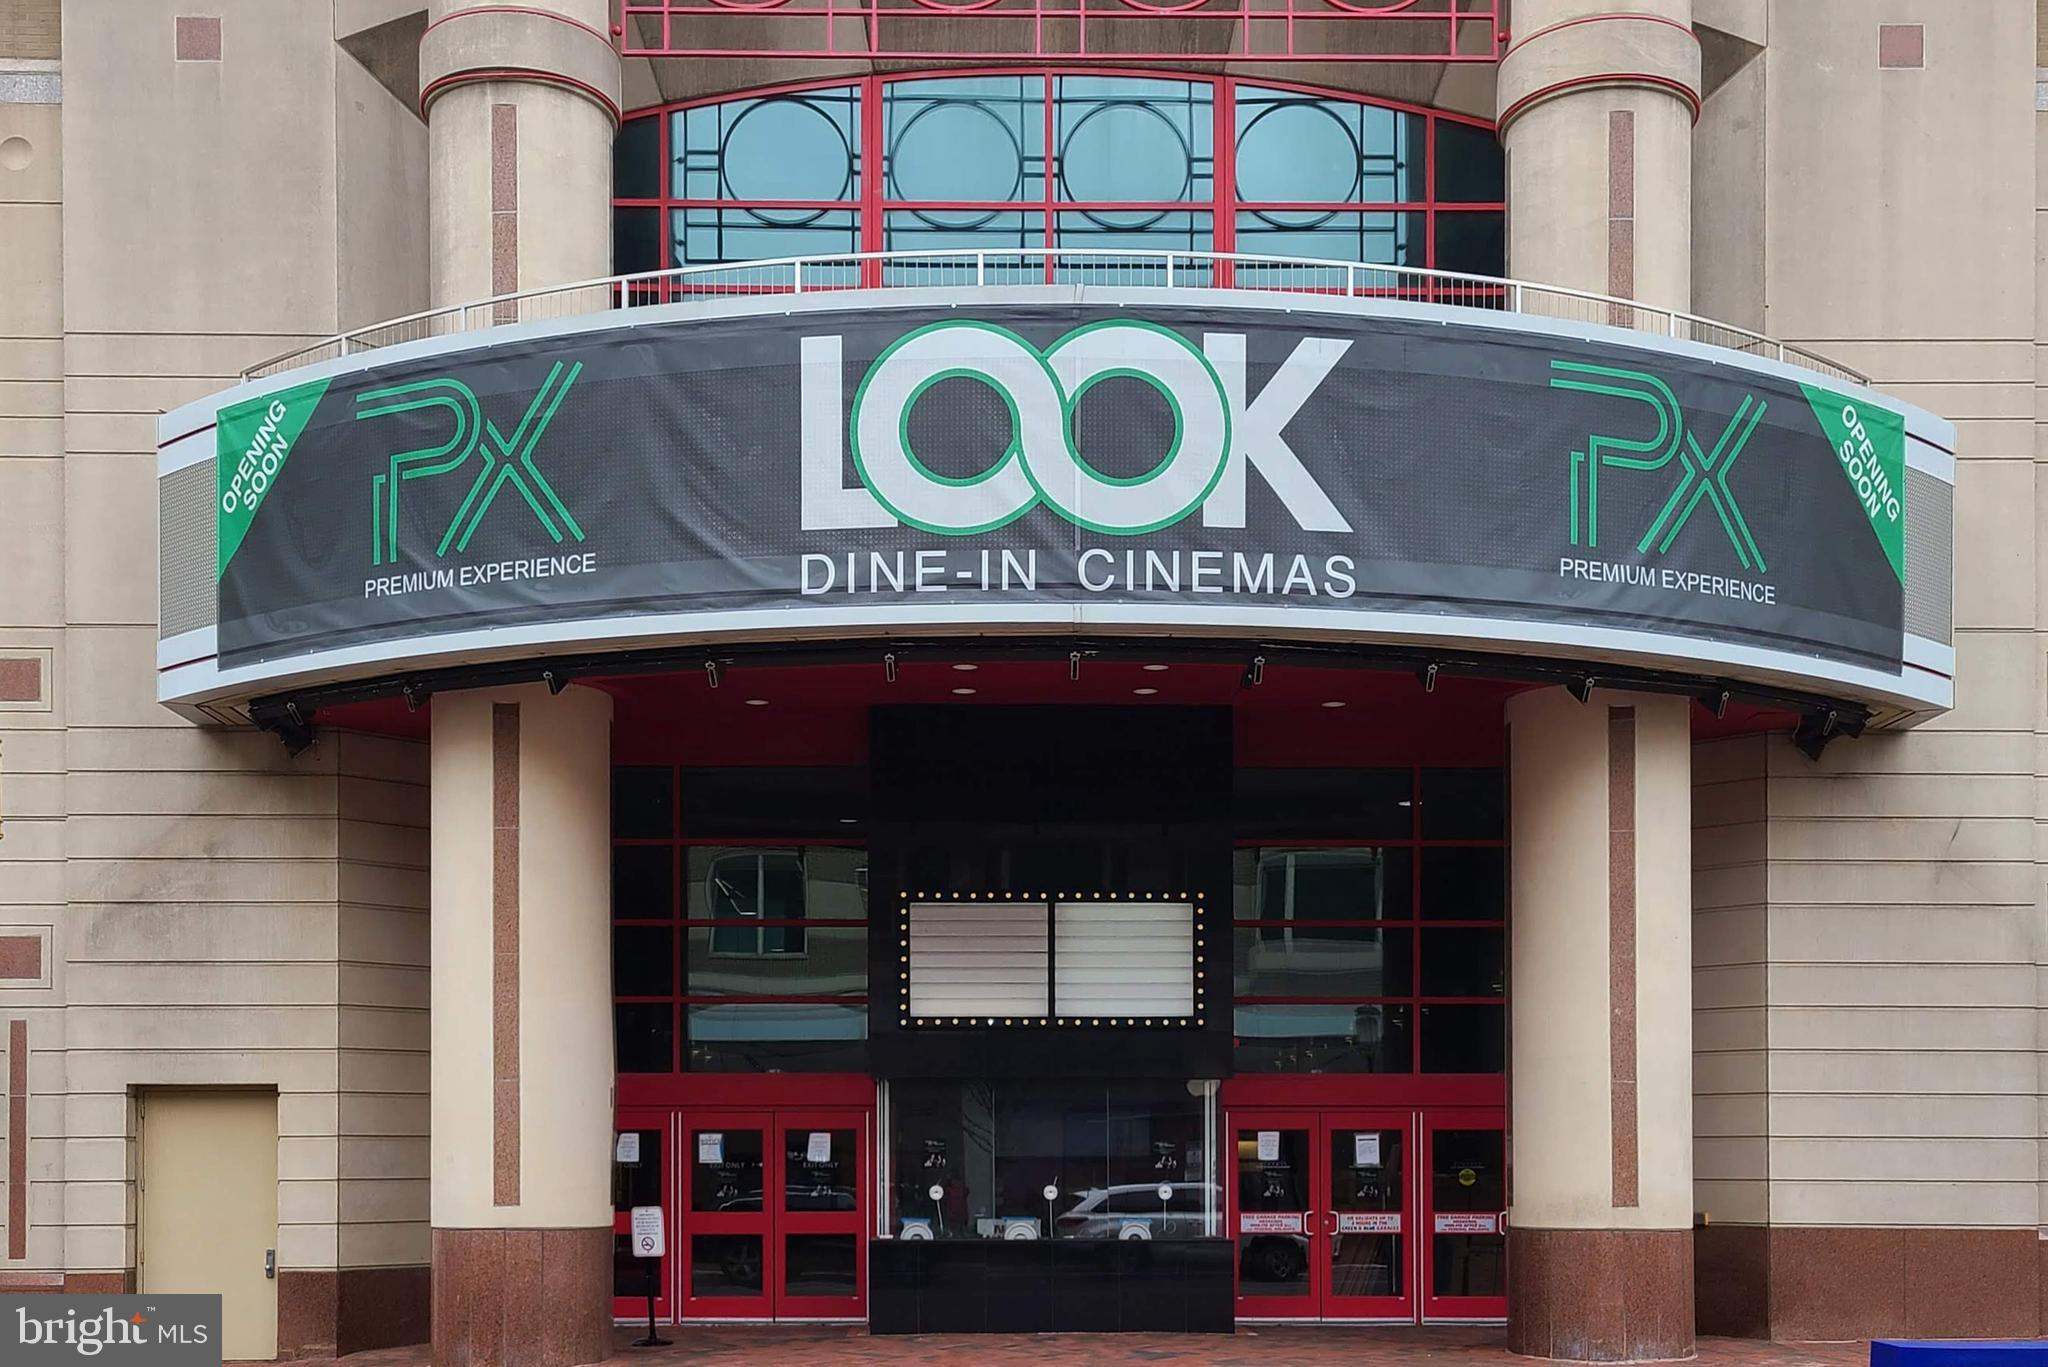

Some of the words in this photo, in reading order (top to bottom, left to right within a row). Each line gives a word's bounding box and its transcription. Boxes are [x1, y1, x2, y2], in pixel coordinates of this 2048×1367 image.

[222, 399, 287, 515] OPENING
[800, 319, 1355, 536] LOOK
[1841, 404, 1901, 523] OPENING
[242, 434, 290, 513] SOON
[1838, 440, 1881, 520] SOON
[364, 567, 455, 600] PREMIUM
[459, 552, 598, 587] EXPERIENCE
[800, 549, 1037, 595] DINE-IN
[1077, 549, 1357, 599] CINEMAS
[1560, 557, 1656, 588] PREMIUM
[1661, 569, 1777, 606] EXPERIENCE
